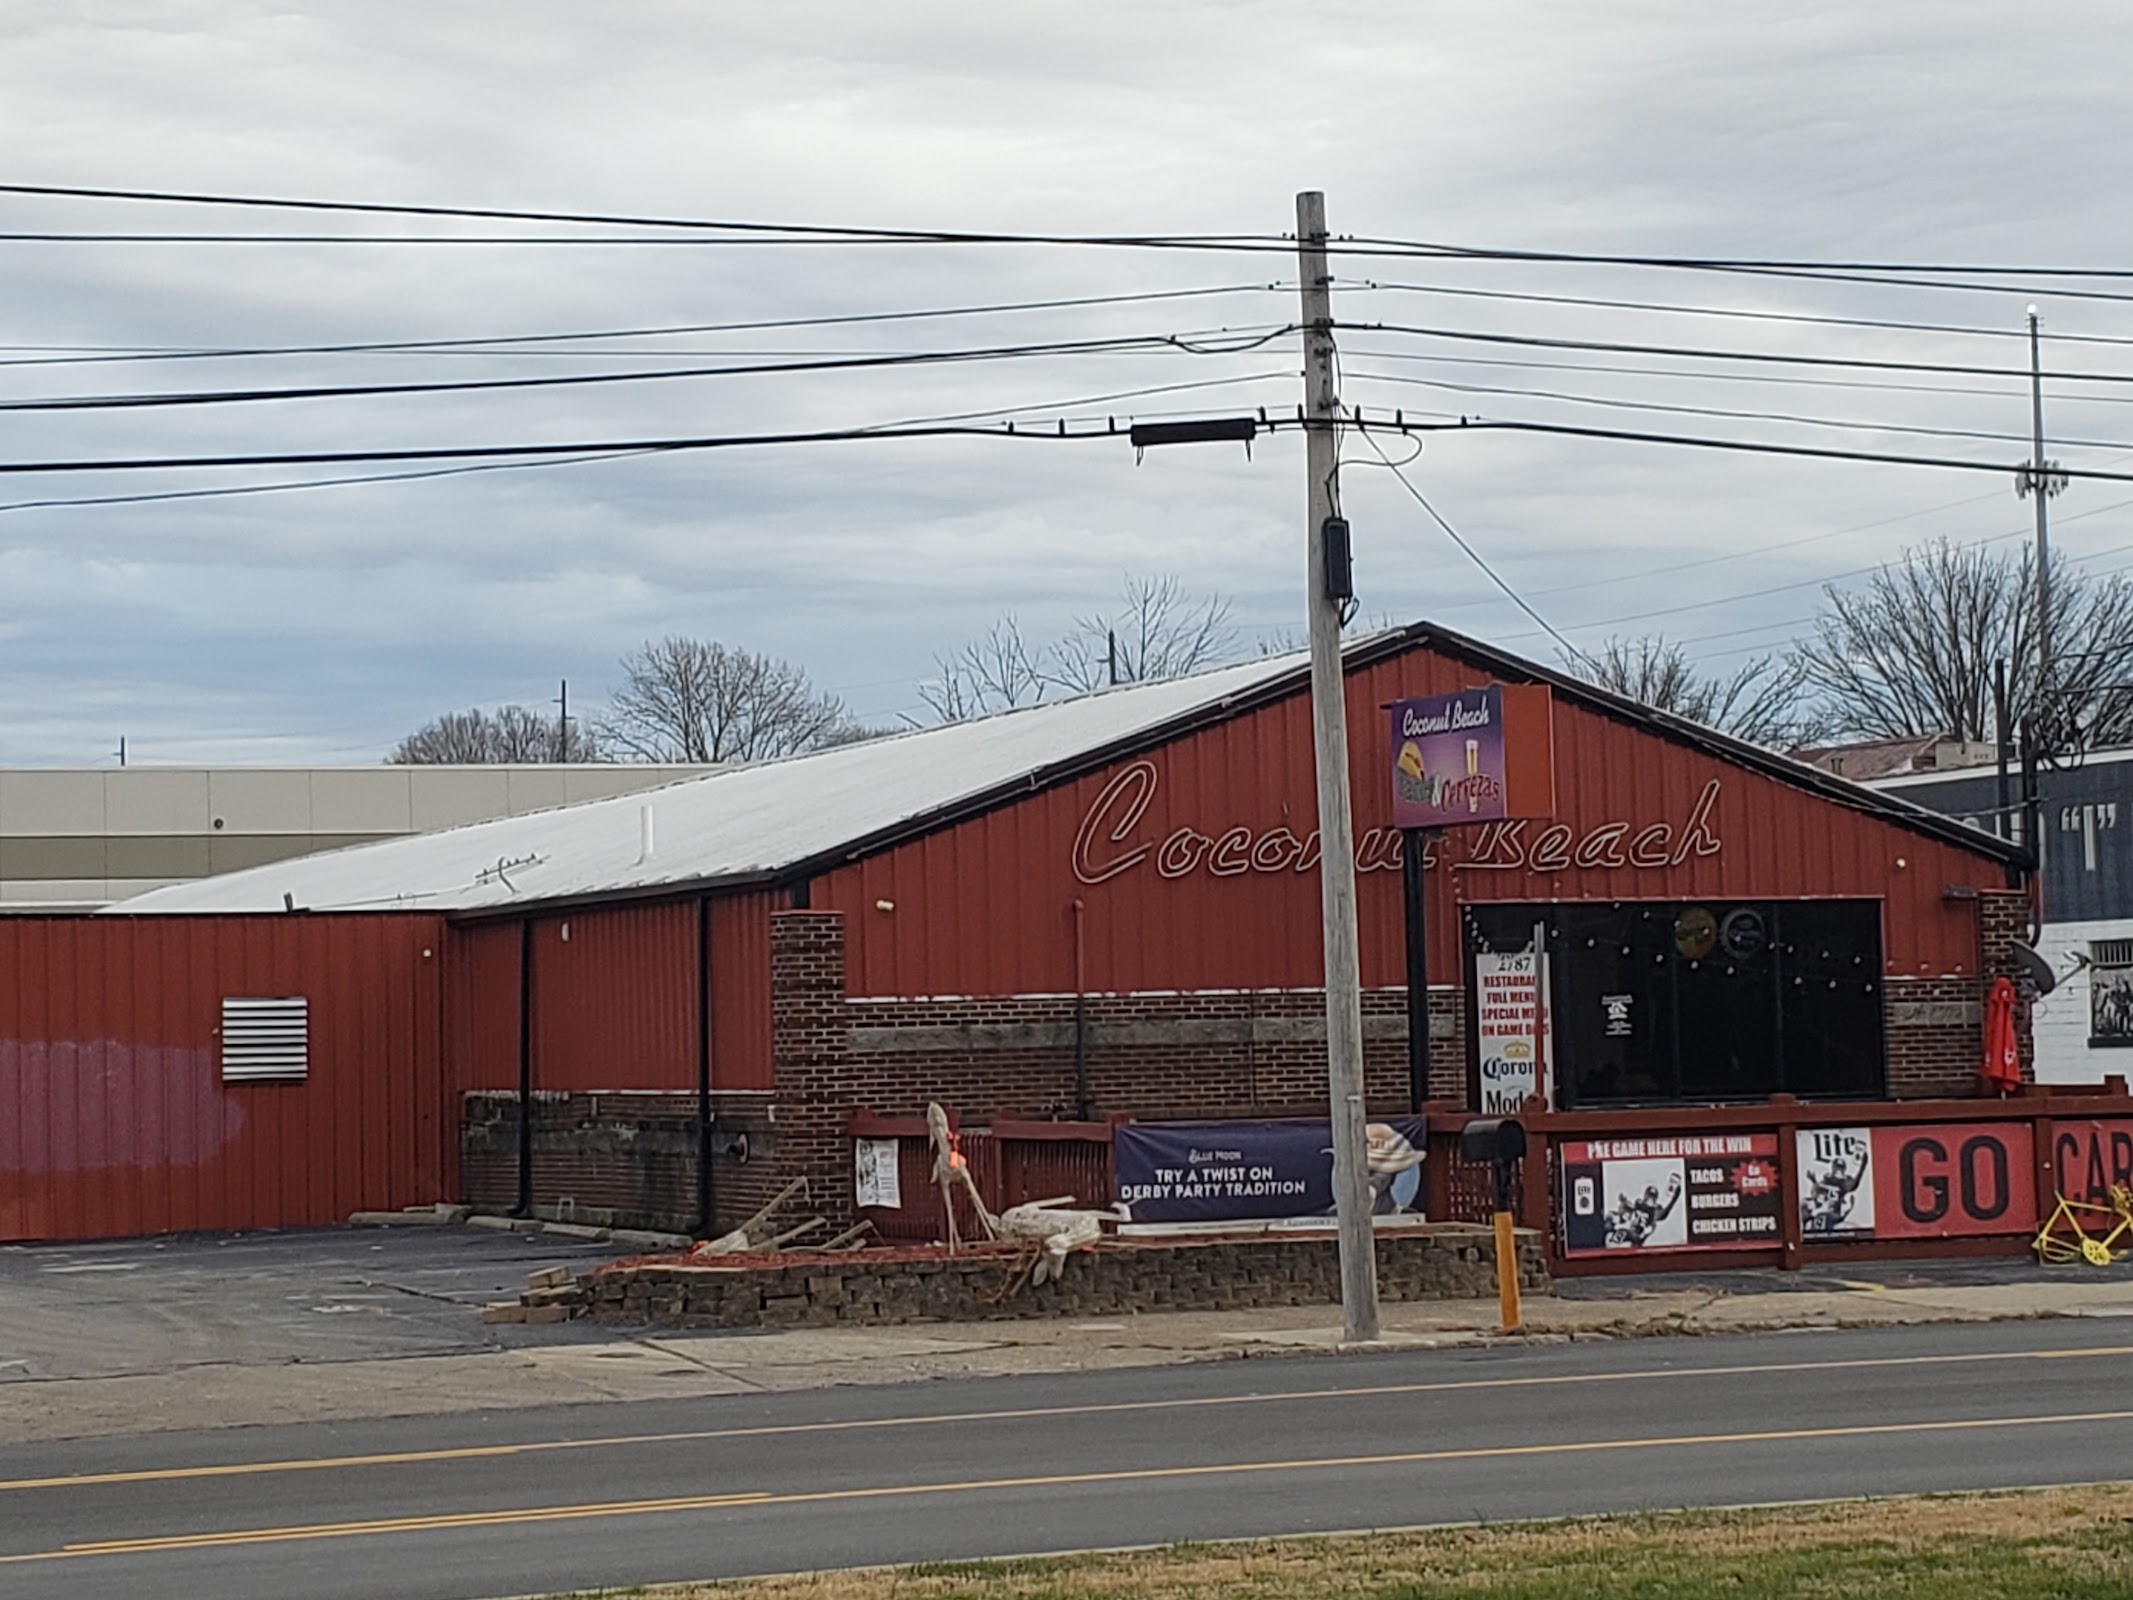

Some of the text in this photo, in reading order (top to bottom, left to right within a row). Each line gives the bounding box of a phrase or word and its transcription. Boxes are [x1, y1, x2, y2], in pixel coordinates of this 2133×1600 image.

[1403, 695, 1490, 736] Coconut Beach
[1612, 1140, 1646, 1158] GAME
[1647, 1139, 1678, 1156] HERE
[1679, 1138, 1701, 1155] FOR
[1702, 1136, 1725, 1154] THE
[1726, 1136, 1752, 1153] WIN
[1814, 1133, 1856, 1164] Lite
[1155, 1166, 1273, 1183] TRY A TWIST ON
[1690, 1168, 1724, 1184] TACOS
[1901, 1135, 2010, 1223] GO
[1121, 1180, 1306, 1200] DERBY PARTY TRADITION
[1691, 1193, 1740, 1209] BURGERS
[1692, 1216, 1777, 1235] CHICKEN STRIPS
